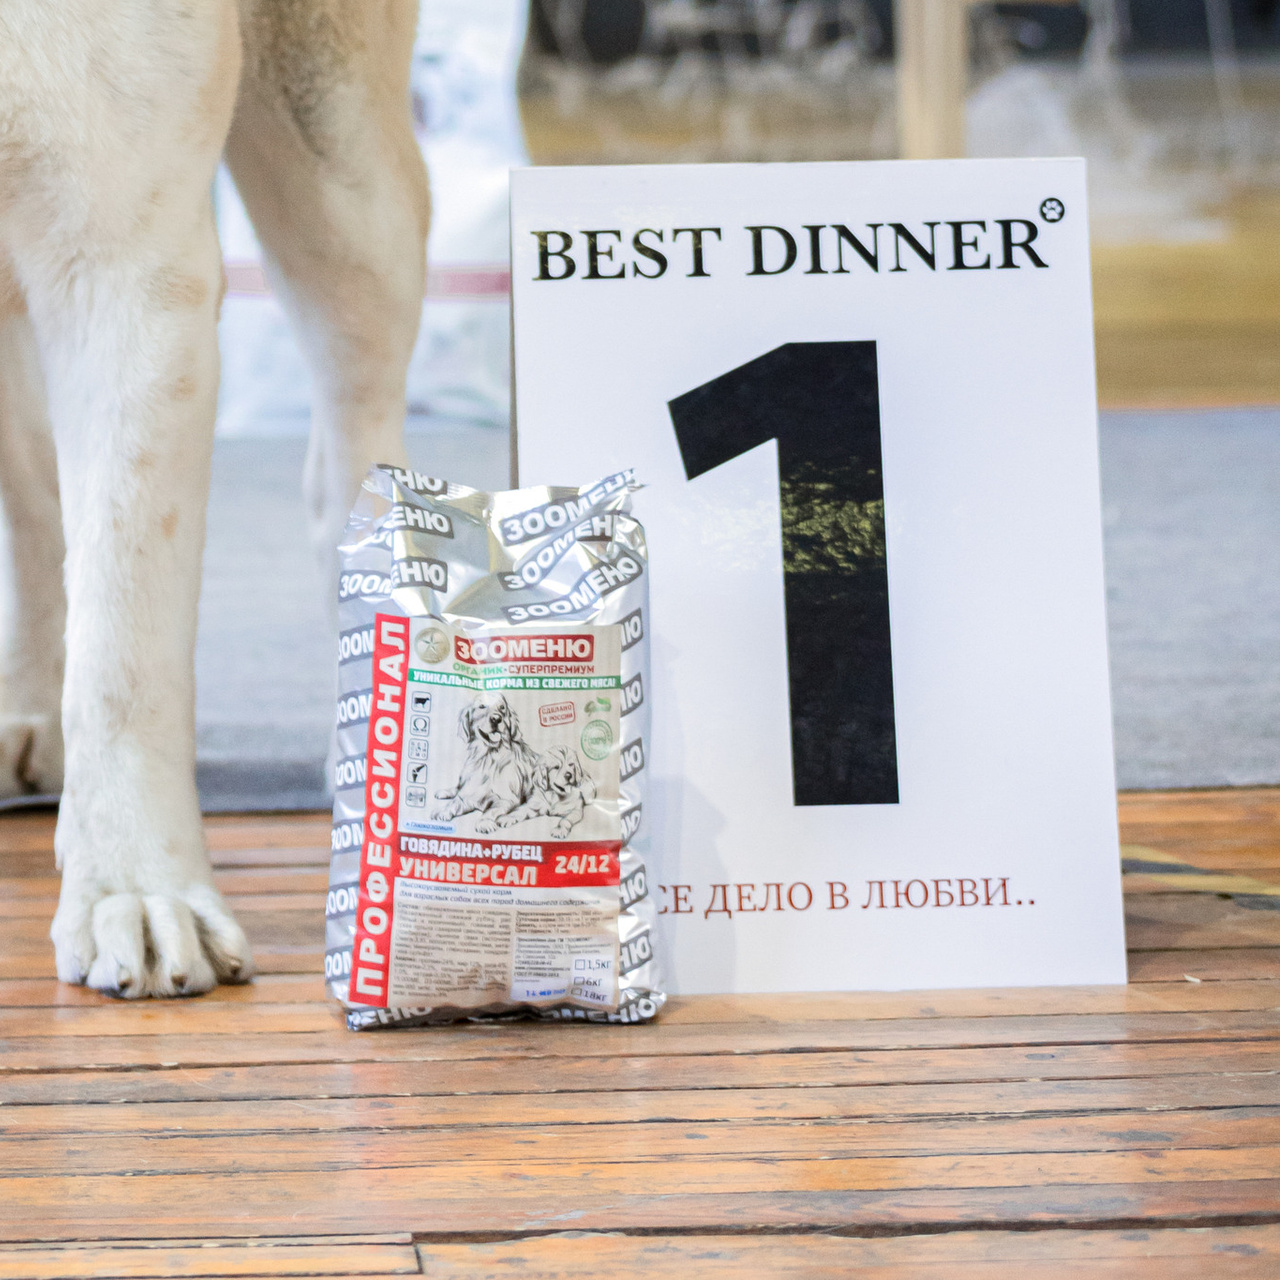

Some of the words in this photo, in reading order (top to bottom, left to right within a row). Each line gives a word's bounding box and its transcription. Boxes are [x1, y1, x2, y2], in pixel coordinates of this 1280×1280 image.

[530, 227, 722, 281] BEST
[744, 218, 1049, 275] DINNER
[667, 339, 899, 806] 1
[457, 638, 592, 661] ЗООМЕНЮ
[413, 670, 484, 689] УНИКАЛЬНЫЕ
[486, 677, 524, 689] КОРМА
[526, 678, 538, 688] ИЗ
[541, 677, 588, 688] СВЕЖЕГО
[356, 620, 406, 997] ПРОФЕССИОНАЛ
[400, 837, 543, 862] ГОВЯДИНА+РУБЕЦ
[399, 857, 537, 886] УНИВЕРСАЛ
[554, 855, 610, 875] 24/12
[704, 881, 814, 920] ДЕЛО
[825, 880, 850, 911] В
[861, 876, 1036, 911] ЛЮБВИ..
